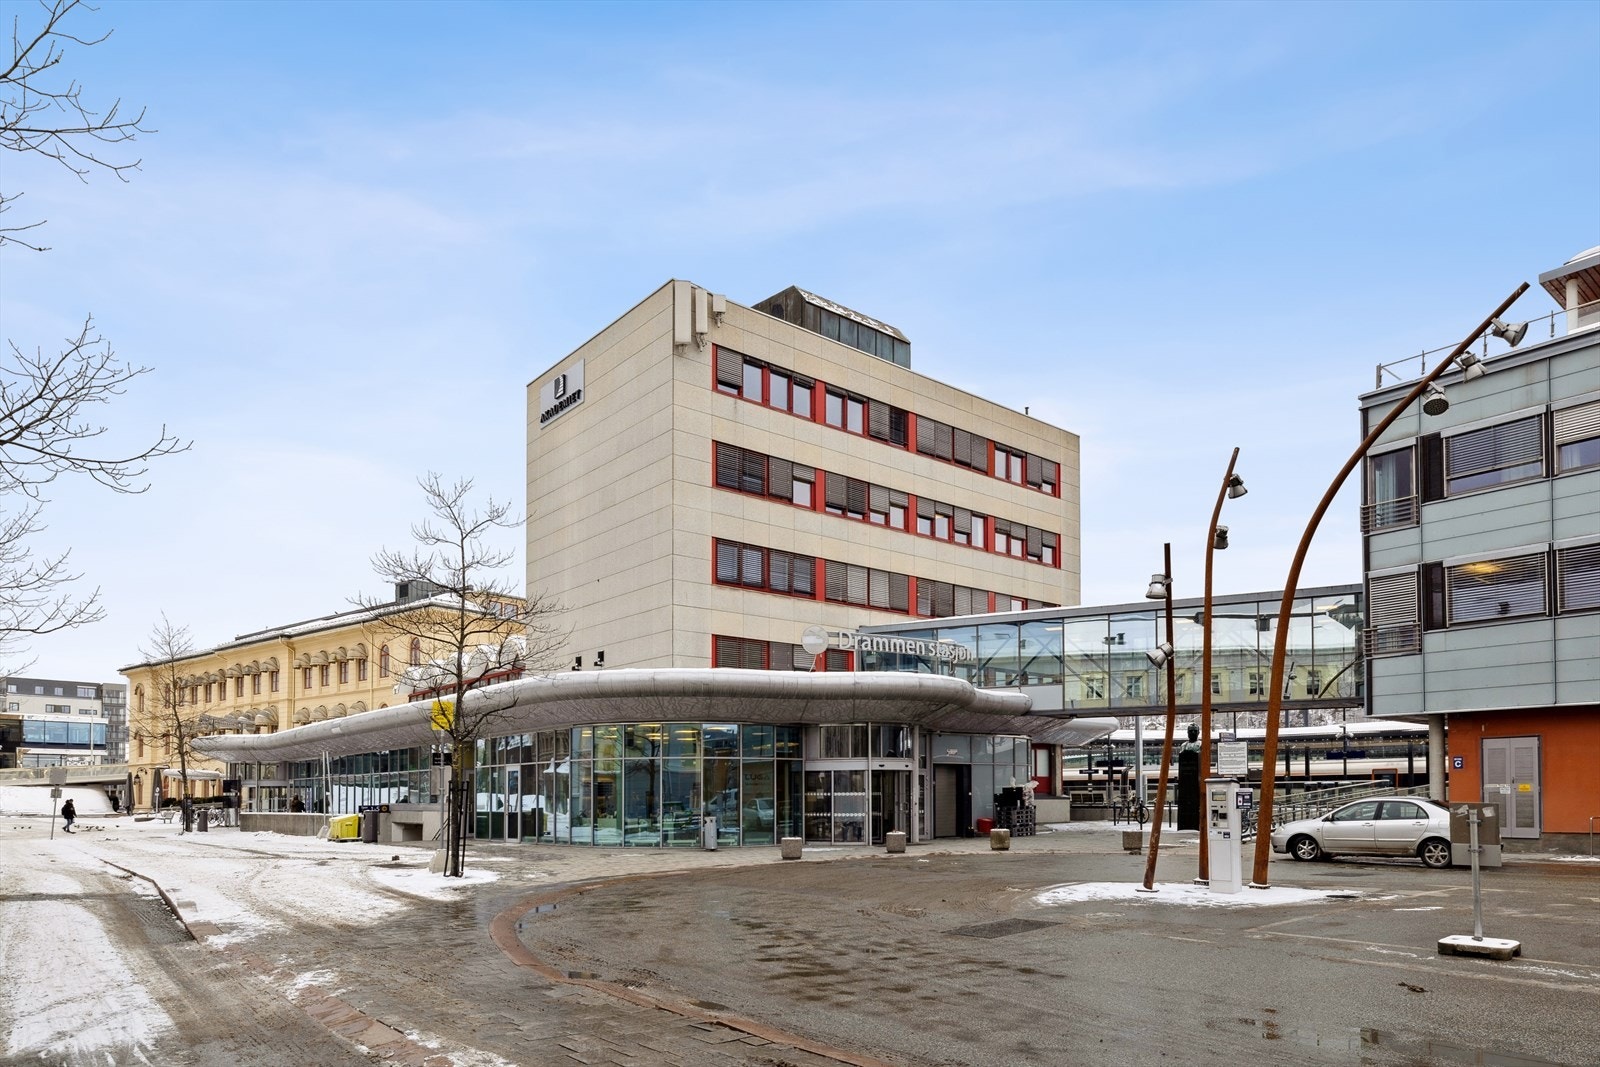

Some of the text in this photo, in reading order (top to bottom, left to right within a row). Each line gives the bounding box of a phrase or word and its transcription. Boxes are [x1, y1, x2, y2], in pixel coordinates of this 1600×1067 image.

[540, 388, 582, 423] AKADEMIET
[838, 632, 974, 664] Drammen stasjon
